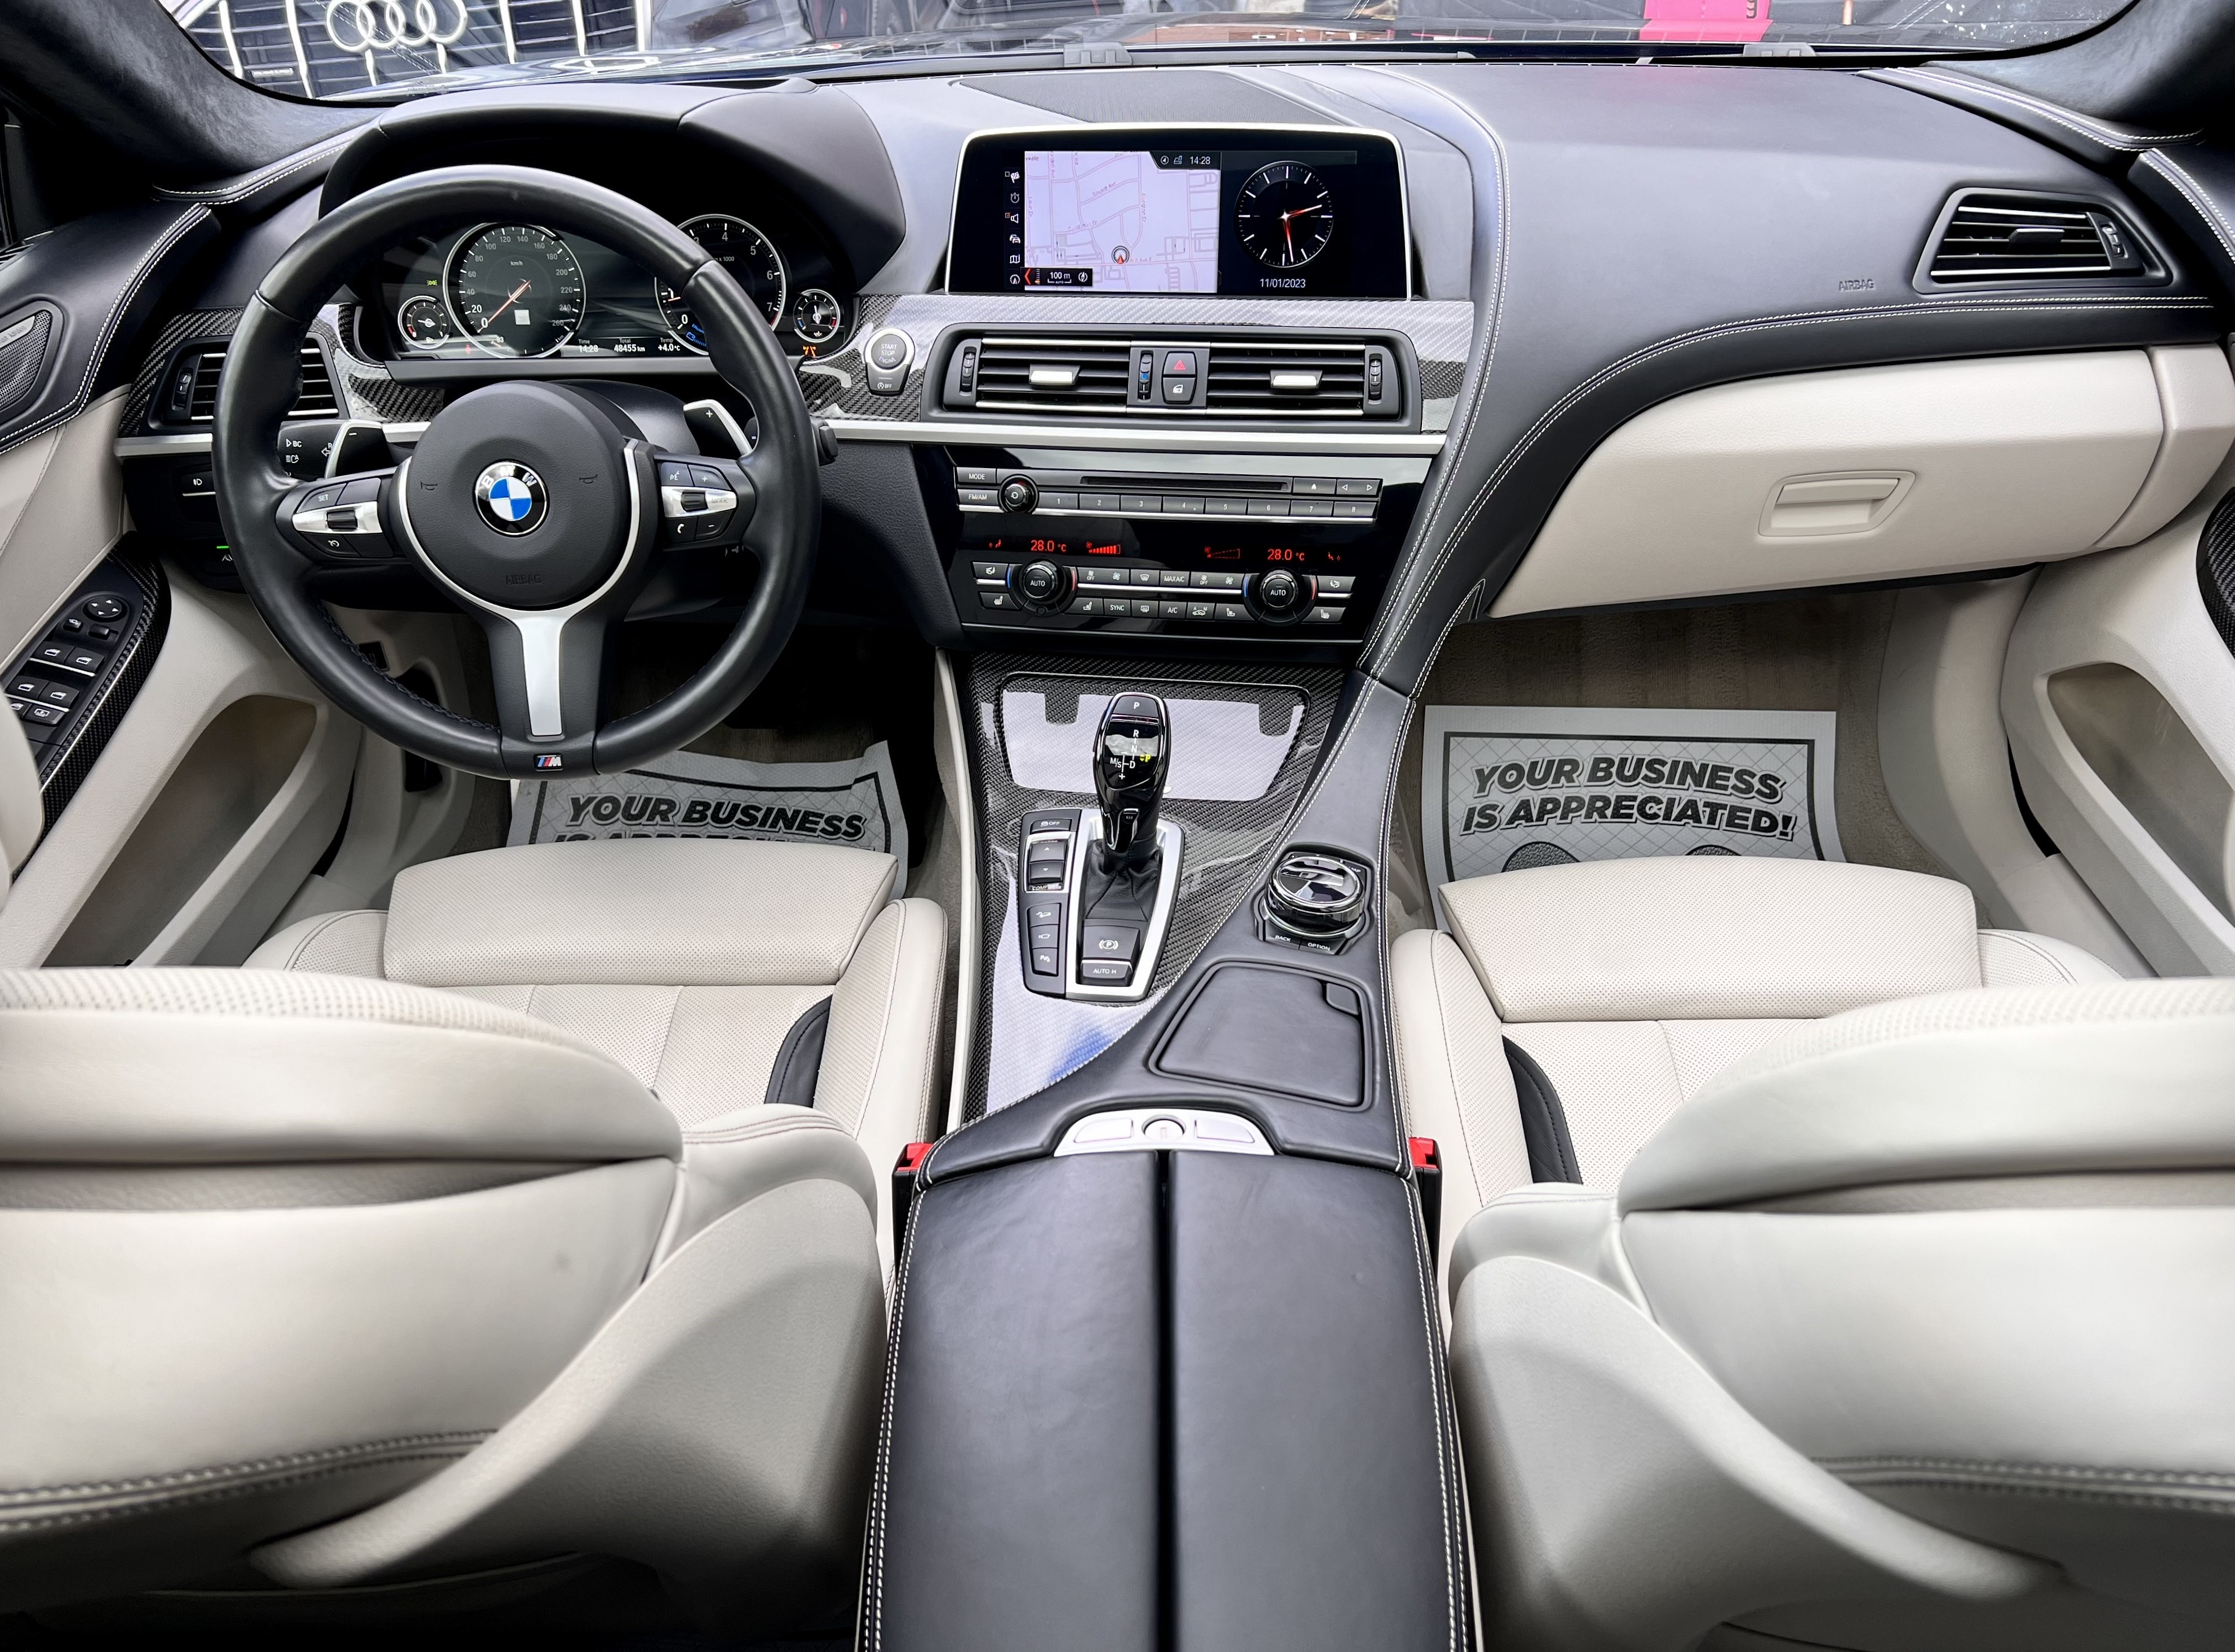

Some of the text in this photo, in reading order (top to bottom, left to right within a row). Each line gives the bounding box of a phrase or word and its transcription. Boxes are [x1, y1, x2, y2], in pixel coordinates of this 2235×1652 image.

[1189, 156, 1211, 165] 14:28
[722, 232, 728, 242] 4
[750, 246, 757, 255] 5
[767, 270, 773, 280] 6
[1260, 278, 1306, 288] 11/01/2023
[1839, 279, 1875, 291] AIRBAG
[472, 305, 482, 313] 20
[767, 302, 772, 312] 7
[481, 318, 488, 328] 0
[681, 314, 688, 324] 0
[579, 344, 598, 353] 14:28
[481, 465, 537, 488] BMW
[1030, 540, 1054, 551] 28.0
[1268, 549, 1292, 560] 28.0
[505, 574, 542, 585] AIRBAG
[1110, 758, 1122, 768] M/S
[1474, 755, 1786, 802] YOUR BUSINESS
[567, 793, 868, 840] YOUR BUSINESS
[1461, 793, 1796, 839] IS APPRECIATED!
[1308, 942, 1330, 951] OPTION
